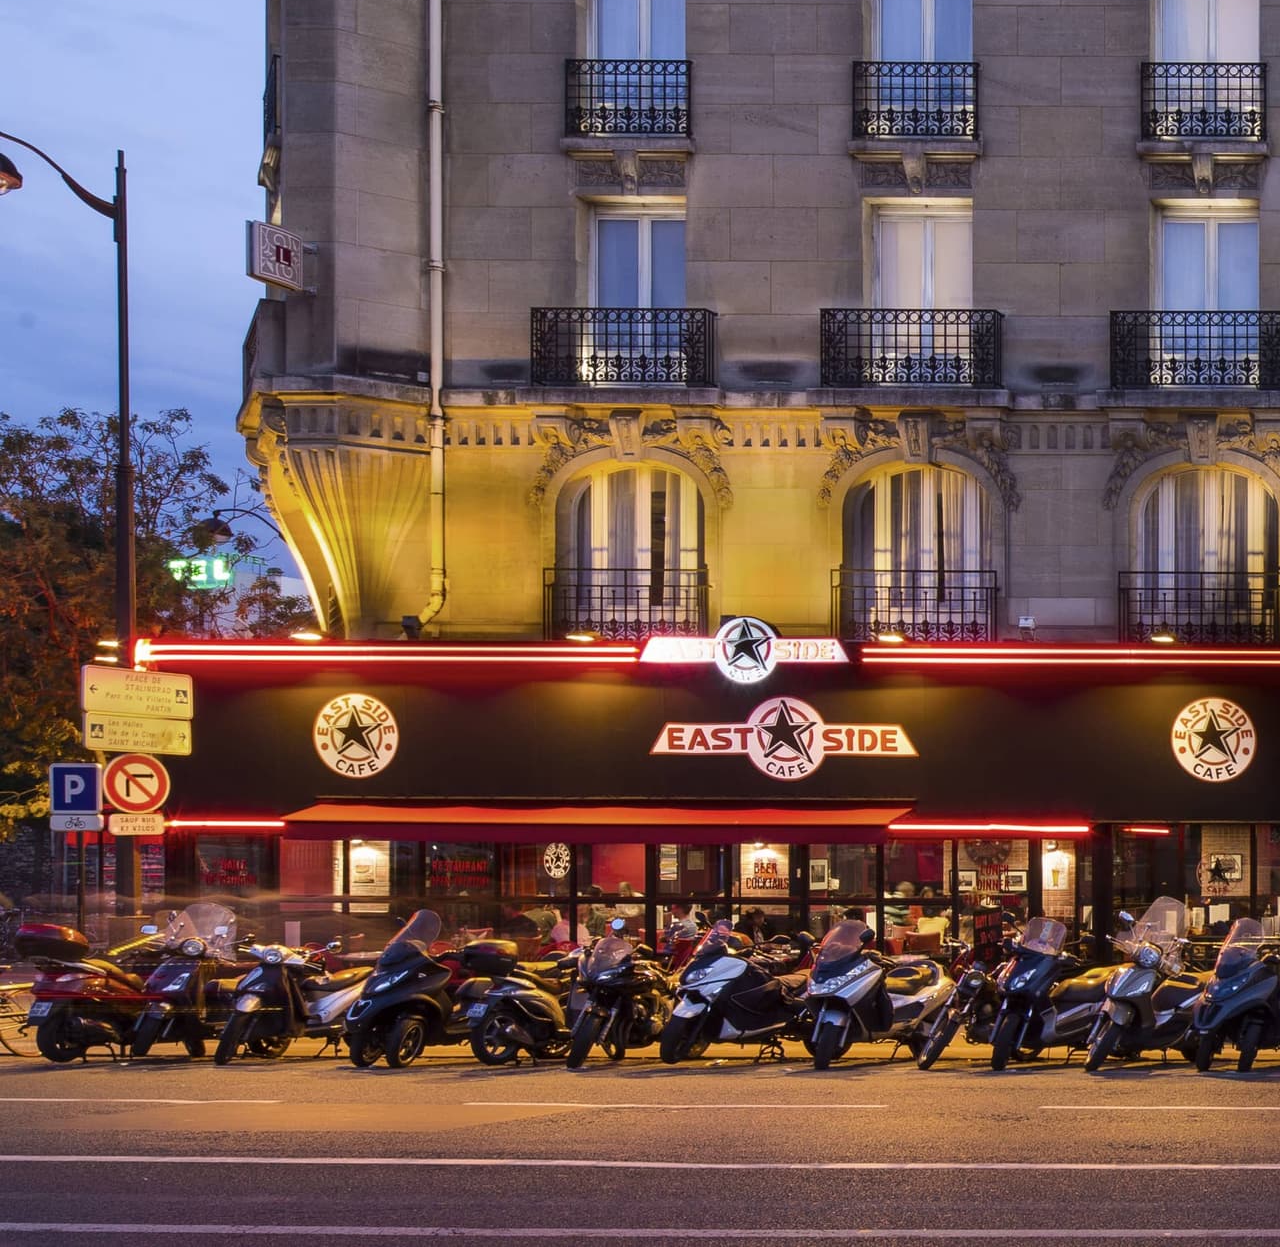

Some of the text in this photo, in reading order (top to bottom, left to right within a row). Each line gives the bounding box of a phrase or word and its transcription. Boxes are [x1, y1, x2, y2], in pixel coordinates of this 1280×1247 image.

[774, 641, 836, 660] SIDE
[125, 674, 161, 684] PLACE DE
[125, 684, 172, 694] STALINGRAD
[105, 692, 121, 700] Parc
[146, 695, 172, 704] Villette
[146, 705, 172, 713] PANTIN
[317, 697, 395, 736] EAST SIDE
[1175, 701, 1253, 740] EAST SIDE
[108, 738, 158, 748] SAINT MICHEL
[667, 727, 898, 752] EAST SIDE
[335, 759, 379, 775] CAFE
[766, 761, 808, 777] CAFE
[1193, 763, 1236, 780] CAFE
[64, 774, 86, 804] P
[754, 862, 778, 874] BEER
[746, 877, 789, 890] COCKTAILS
[977, 879, 1009, 892] DINNER
